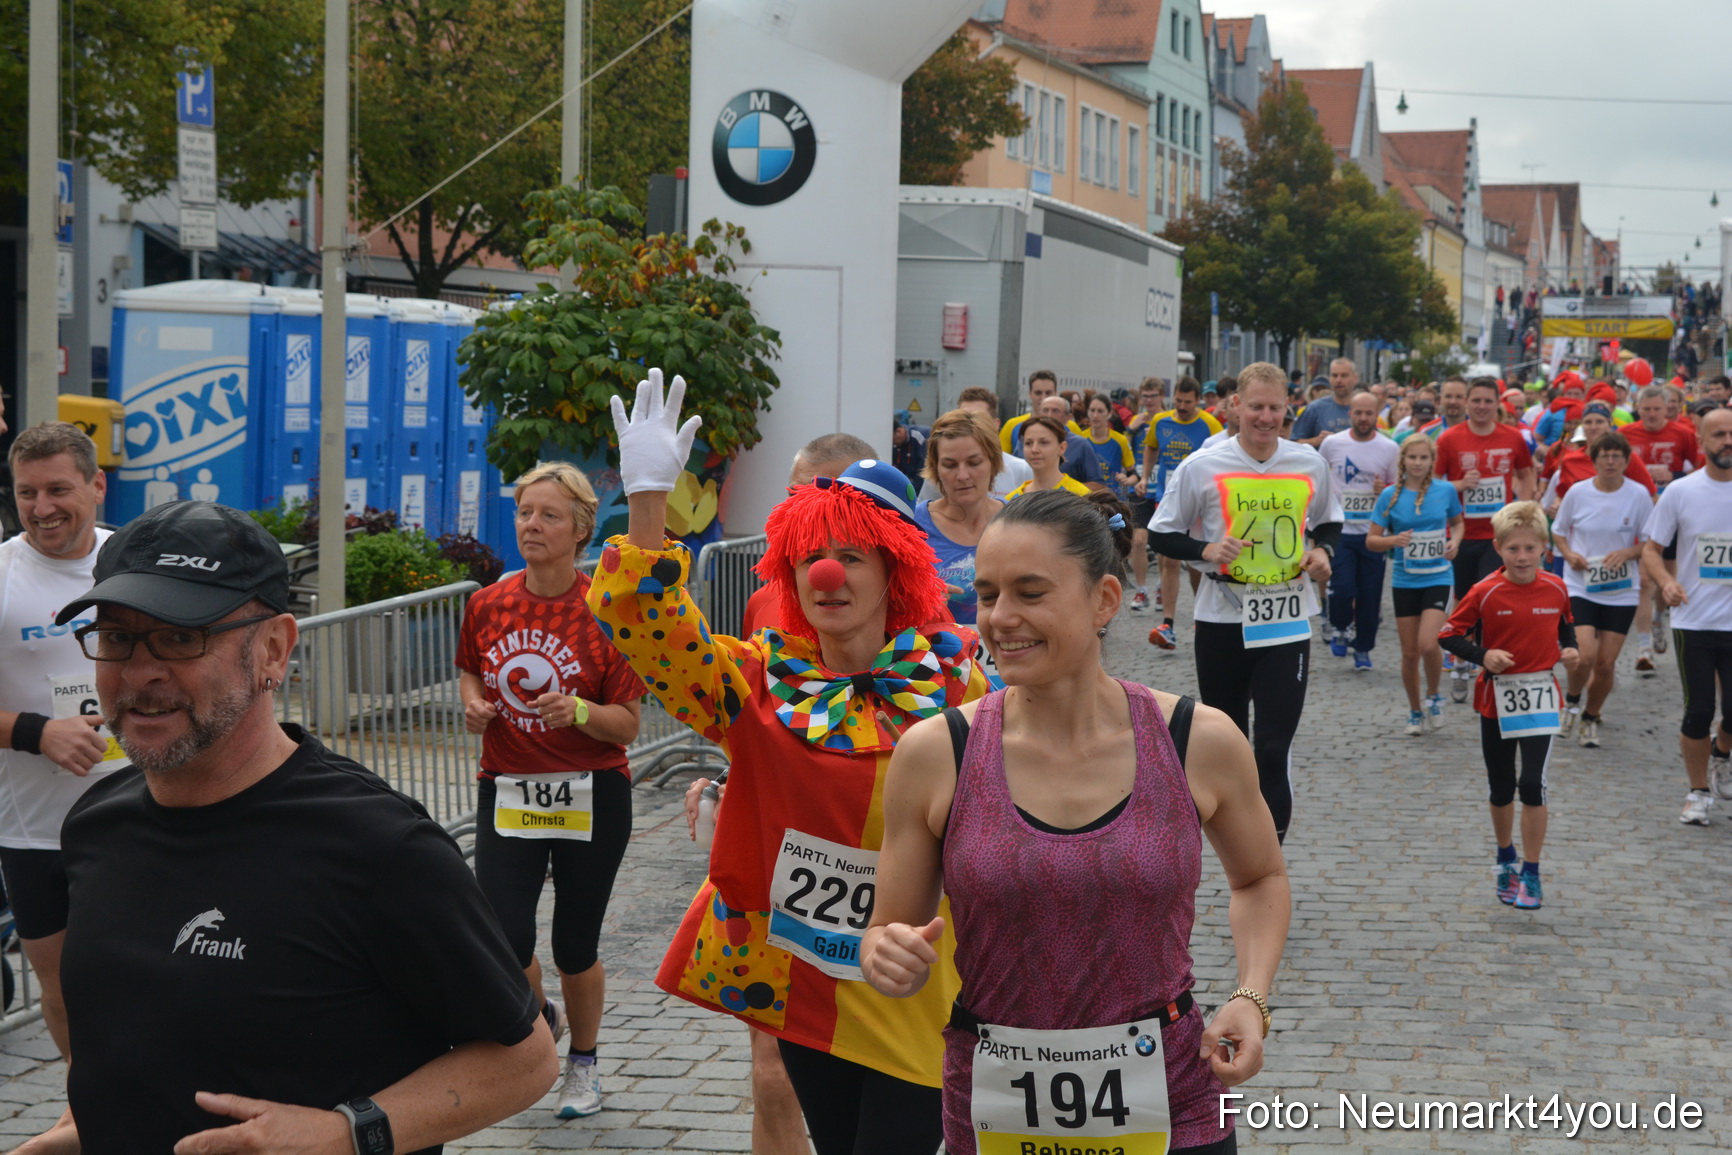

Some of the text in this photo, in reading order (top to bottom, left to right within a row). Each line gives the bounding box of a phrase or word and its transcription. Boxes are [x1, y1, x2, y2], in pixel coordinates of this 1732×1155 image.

[720, 92, 808, 131] BMW
[1585, 322, 1630, 335] START
[1237, 492, 1293, 512] heute
[1344, 496, 1376, 511] 2827
[1467, 486, 1502, 503] 2394
[155, 553, 222, 572] 2XU
[1408, 540, 1444, 558] 2760
[1247, 594, 1301, 622] 3370
[487, 628, 582, 680] FINISHER
[54, 684, 93, 696] PARTL
[1503, 685, 1555, 714] 3371
[494, 698, 534, 733] RELAY
[515, 779, 574, 809] 184
[521, 812, 566, 827] Christa
[783, 841, 878, 876] PARTL Neum
[783, 866, 876, 930] 229
[190, 932, 247, 960] Frank
[813, 935, 858, 961] Gabi
[978, 1039, 1129, 1063] PARTL Neumarkt
[1010, 1068, 1131, 1130] 194
